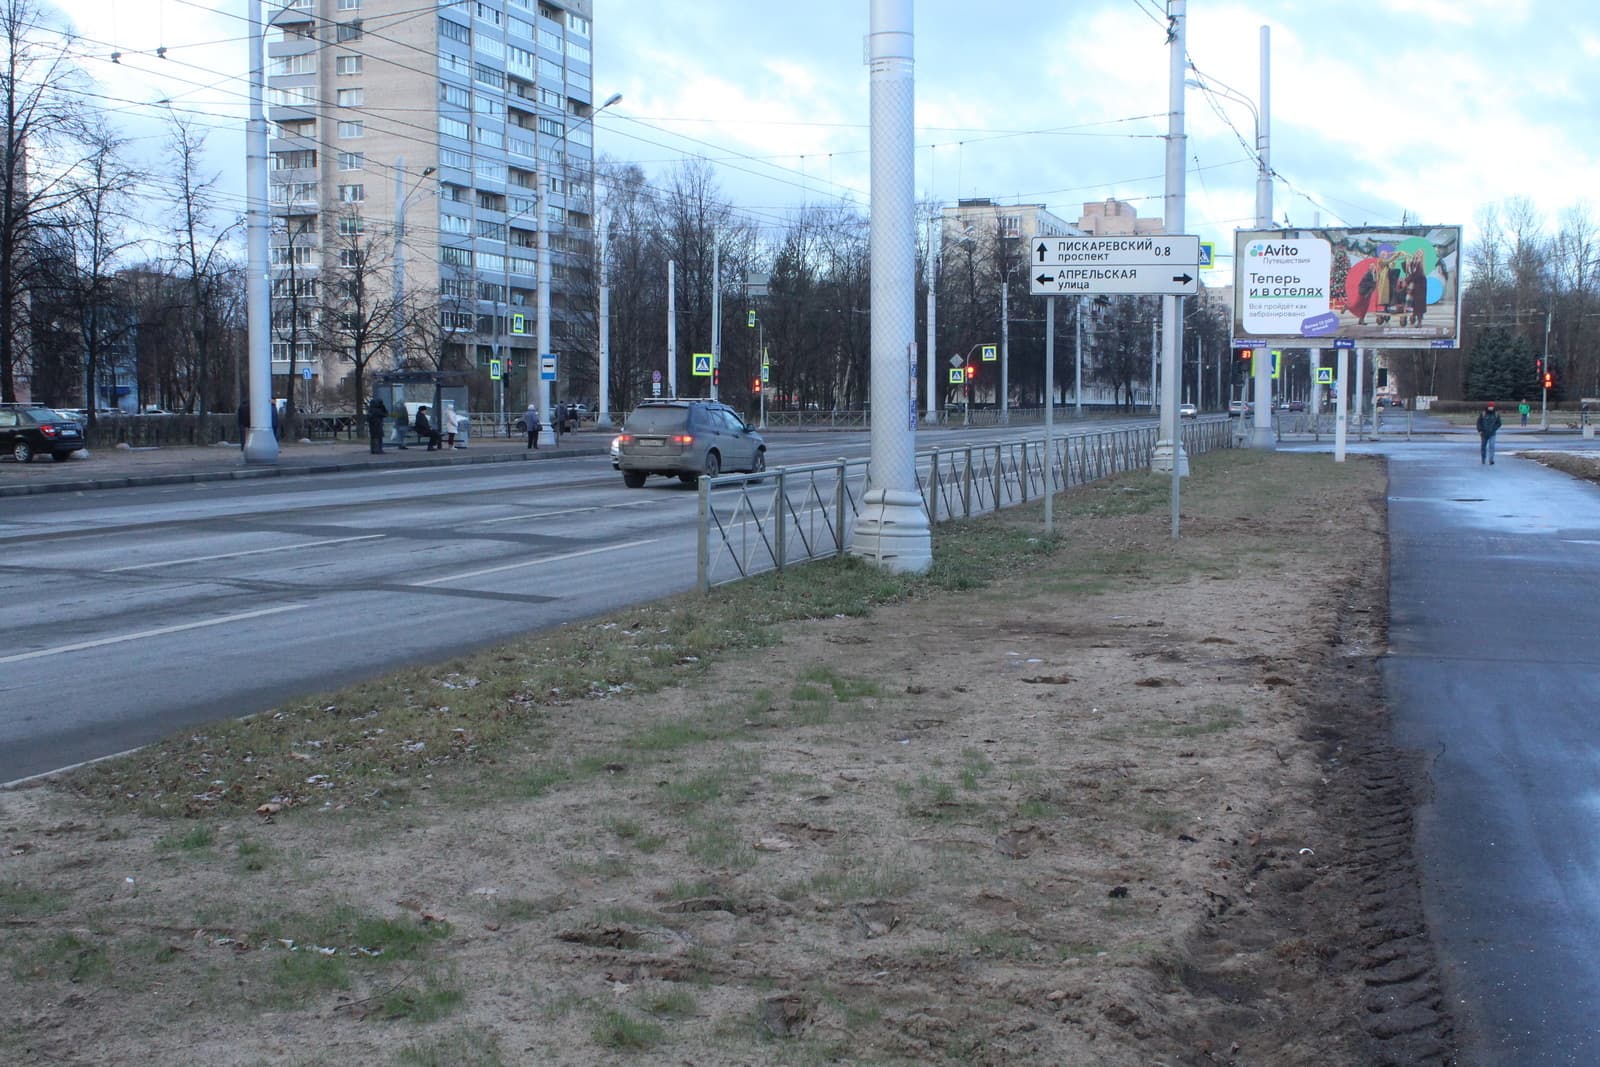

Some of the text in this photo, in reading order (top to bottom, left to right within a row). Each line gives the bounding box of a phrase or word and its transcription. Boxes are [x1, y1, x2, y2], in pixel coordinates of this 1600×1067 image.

[1058, 238, 1152, 251] ПИСКАРЕВСКИЙ
[1154, 246, 1171, 257] 0.8
[1264, 244, 1298, 256] Avito
[1058, 253, 1109, 263] проспект
[1058, 269, 1137, 279] АПРЕЛЬСКАЯ
[1250, 272, 1301, 286] Теперь
[1058, 281, 1090, 291] улица
[1250, 287, 1323, 296] и в отелях
